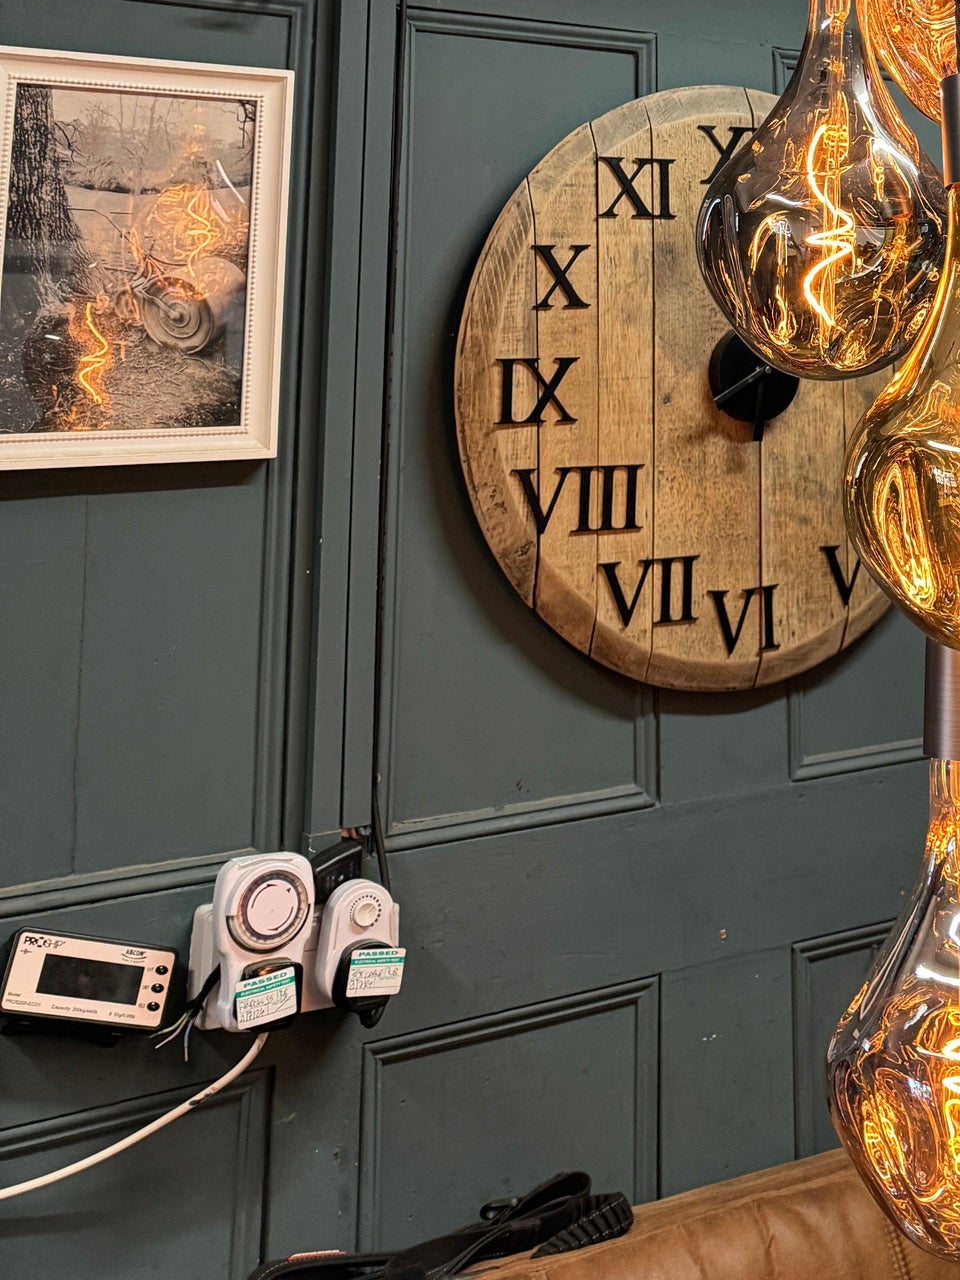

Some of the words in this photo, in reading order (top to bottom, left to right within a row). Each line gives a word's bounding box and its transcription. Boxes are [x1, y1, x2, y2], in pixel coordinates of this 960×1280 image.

[598, 156, 677, 219] XI
[532, 244, 591, 310] X
[494, 357, 580, 426] IX
[510, 464, 645, 534] VIII
[597, 555, 700, 628] VII
[706, 584, 781, 657] VI
[243, 972, 287, 988] PASSED
